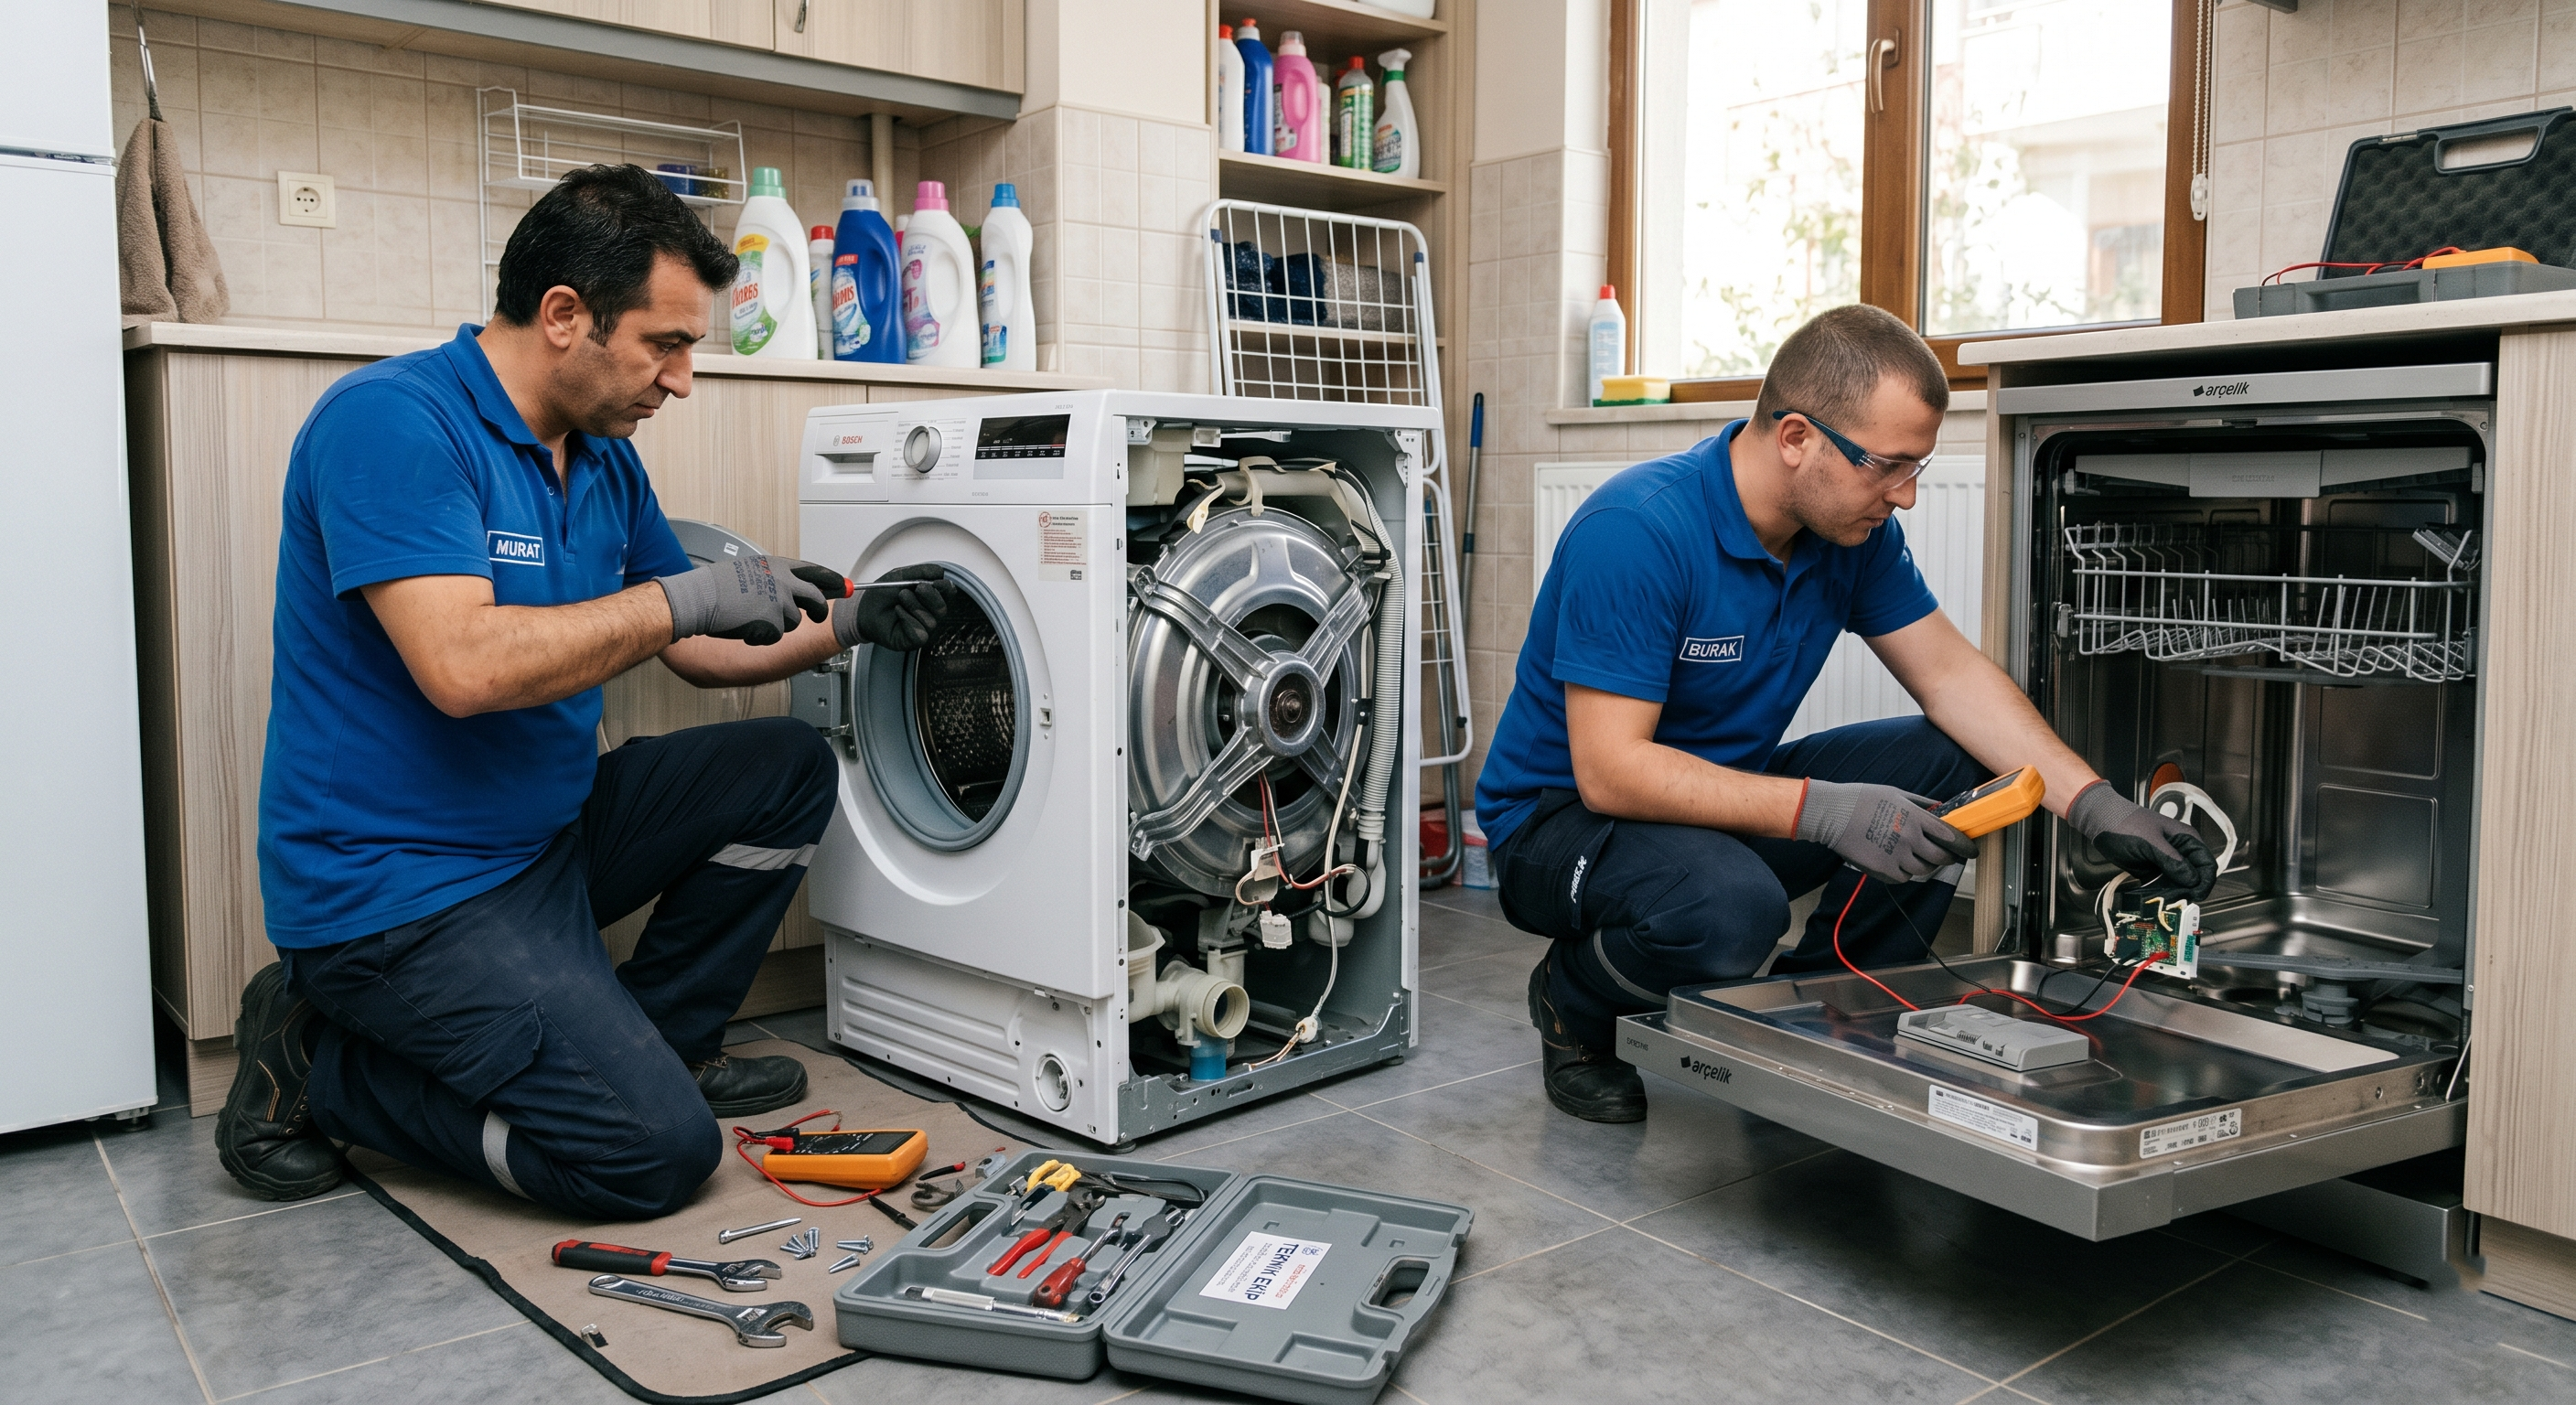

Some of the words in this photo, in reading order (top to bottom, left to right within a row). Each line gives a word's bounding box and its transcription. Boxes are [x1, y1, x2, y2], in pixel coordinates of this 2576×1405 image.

[496, 539, 541, 559] MURAT
[1688, 641, 1738, 658] BURAK
[1691, 1060, 1733, 1084] arçelik
